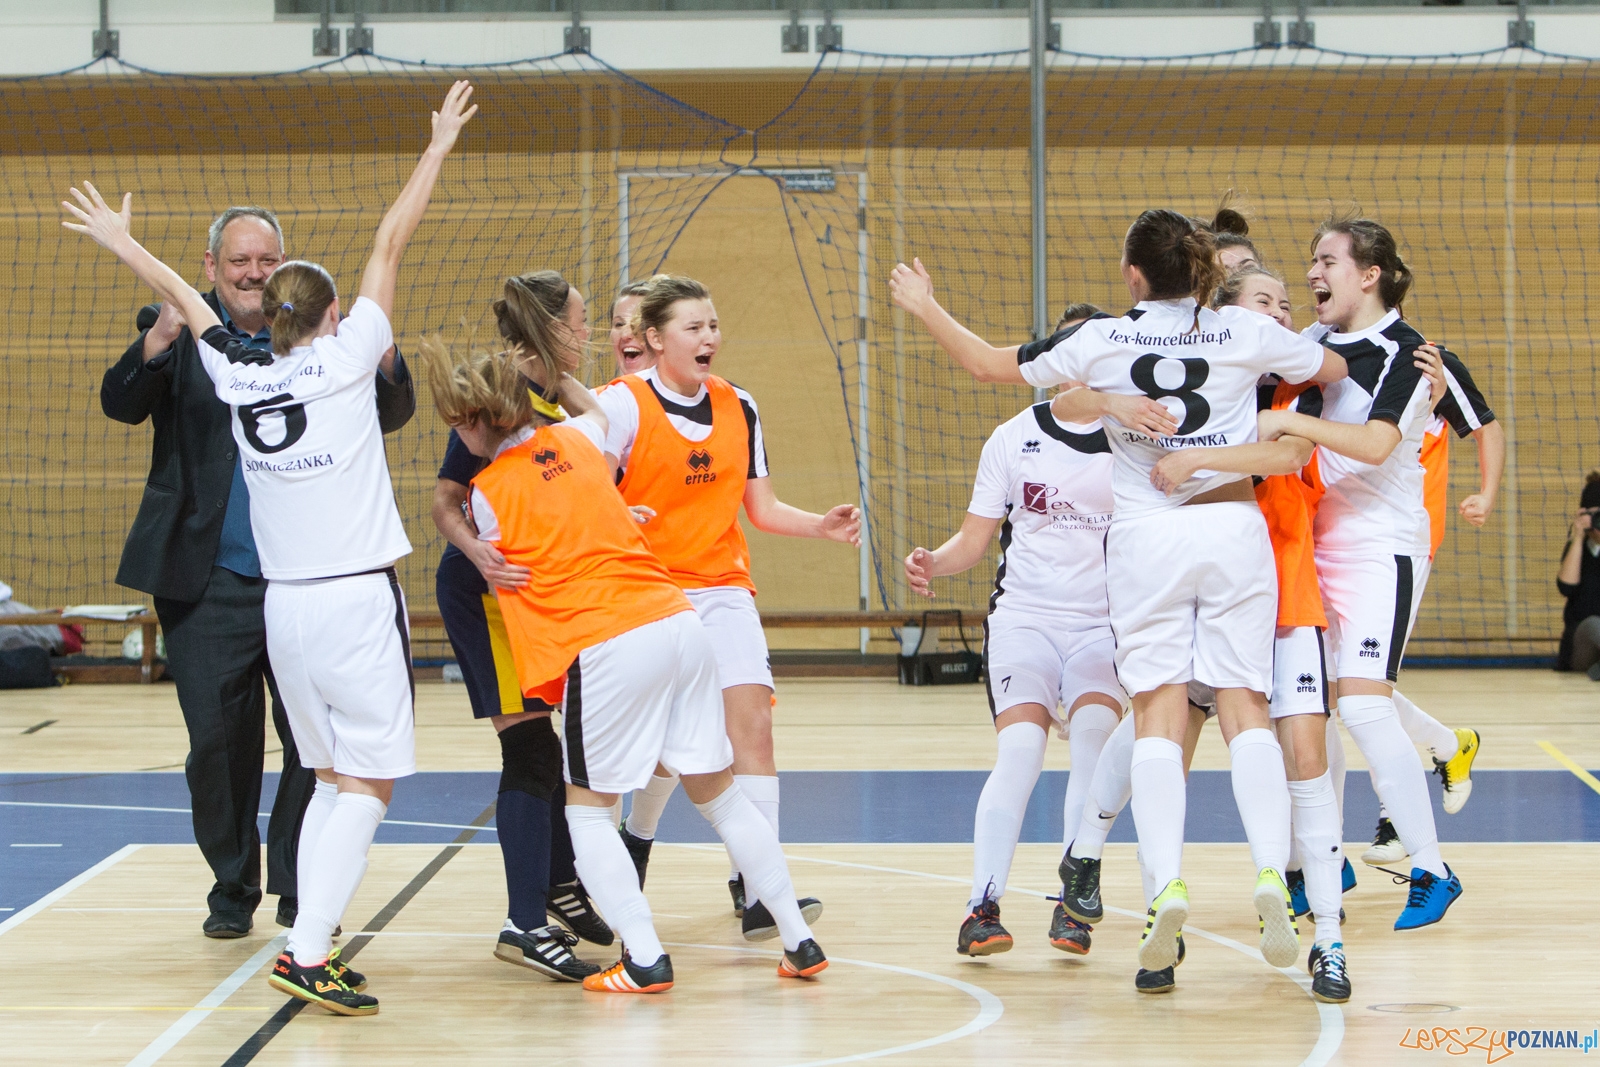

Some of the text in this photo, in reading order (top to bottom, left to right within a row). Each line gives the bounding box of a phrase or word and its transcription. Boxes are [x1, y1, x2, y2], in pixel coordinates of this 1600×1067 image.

[1109, 328, 1232, 346] lex-kancelaria.pl
[1130, 353, 1211, 436] 8
[238, 392, 307, 454] 6
[941, 663, 968, 673] SELECT
[1001, 675, 1012, 693] 7
